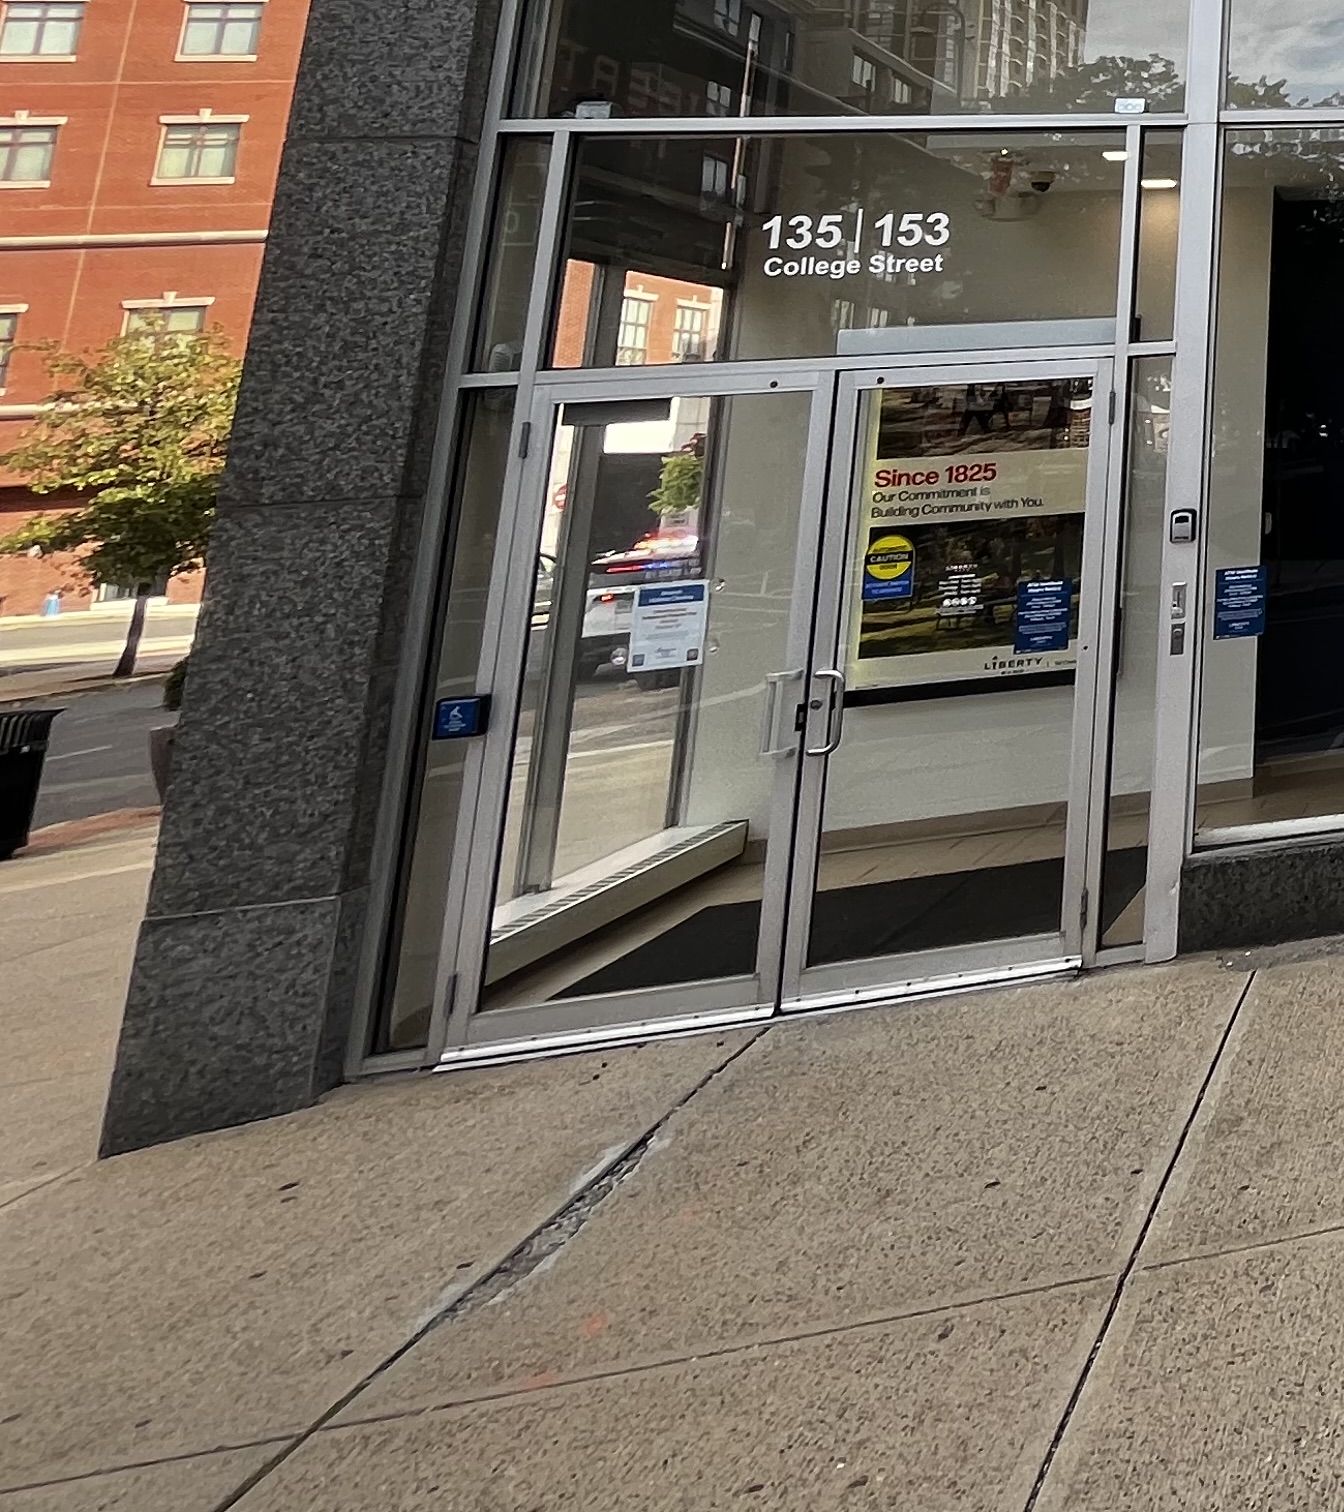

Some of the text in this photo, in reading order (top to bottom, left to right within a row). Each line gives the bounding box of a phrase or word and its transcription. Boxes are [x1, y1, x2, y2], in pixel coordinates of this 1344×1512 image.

[762, 212, 950, 250] 135 153
[763, 254, 944, 280] College Street
[874, 462, 997, 488] Since 1825
[872, 486, 991, 504] Our Commitment is
[871, 505, 920, 519] Building
[921, 500, 992, 515] Community
[993, 498, 1018, 510] with
[870, 553, 909, 563] CAUTION
[984, 655, 1044, 670] LIBERTY
